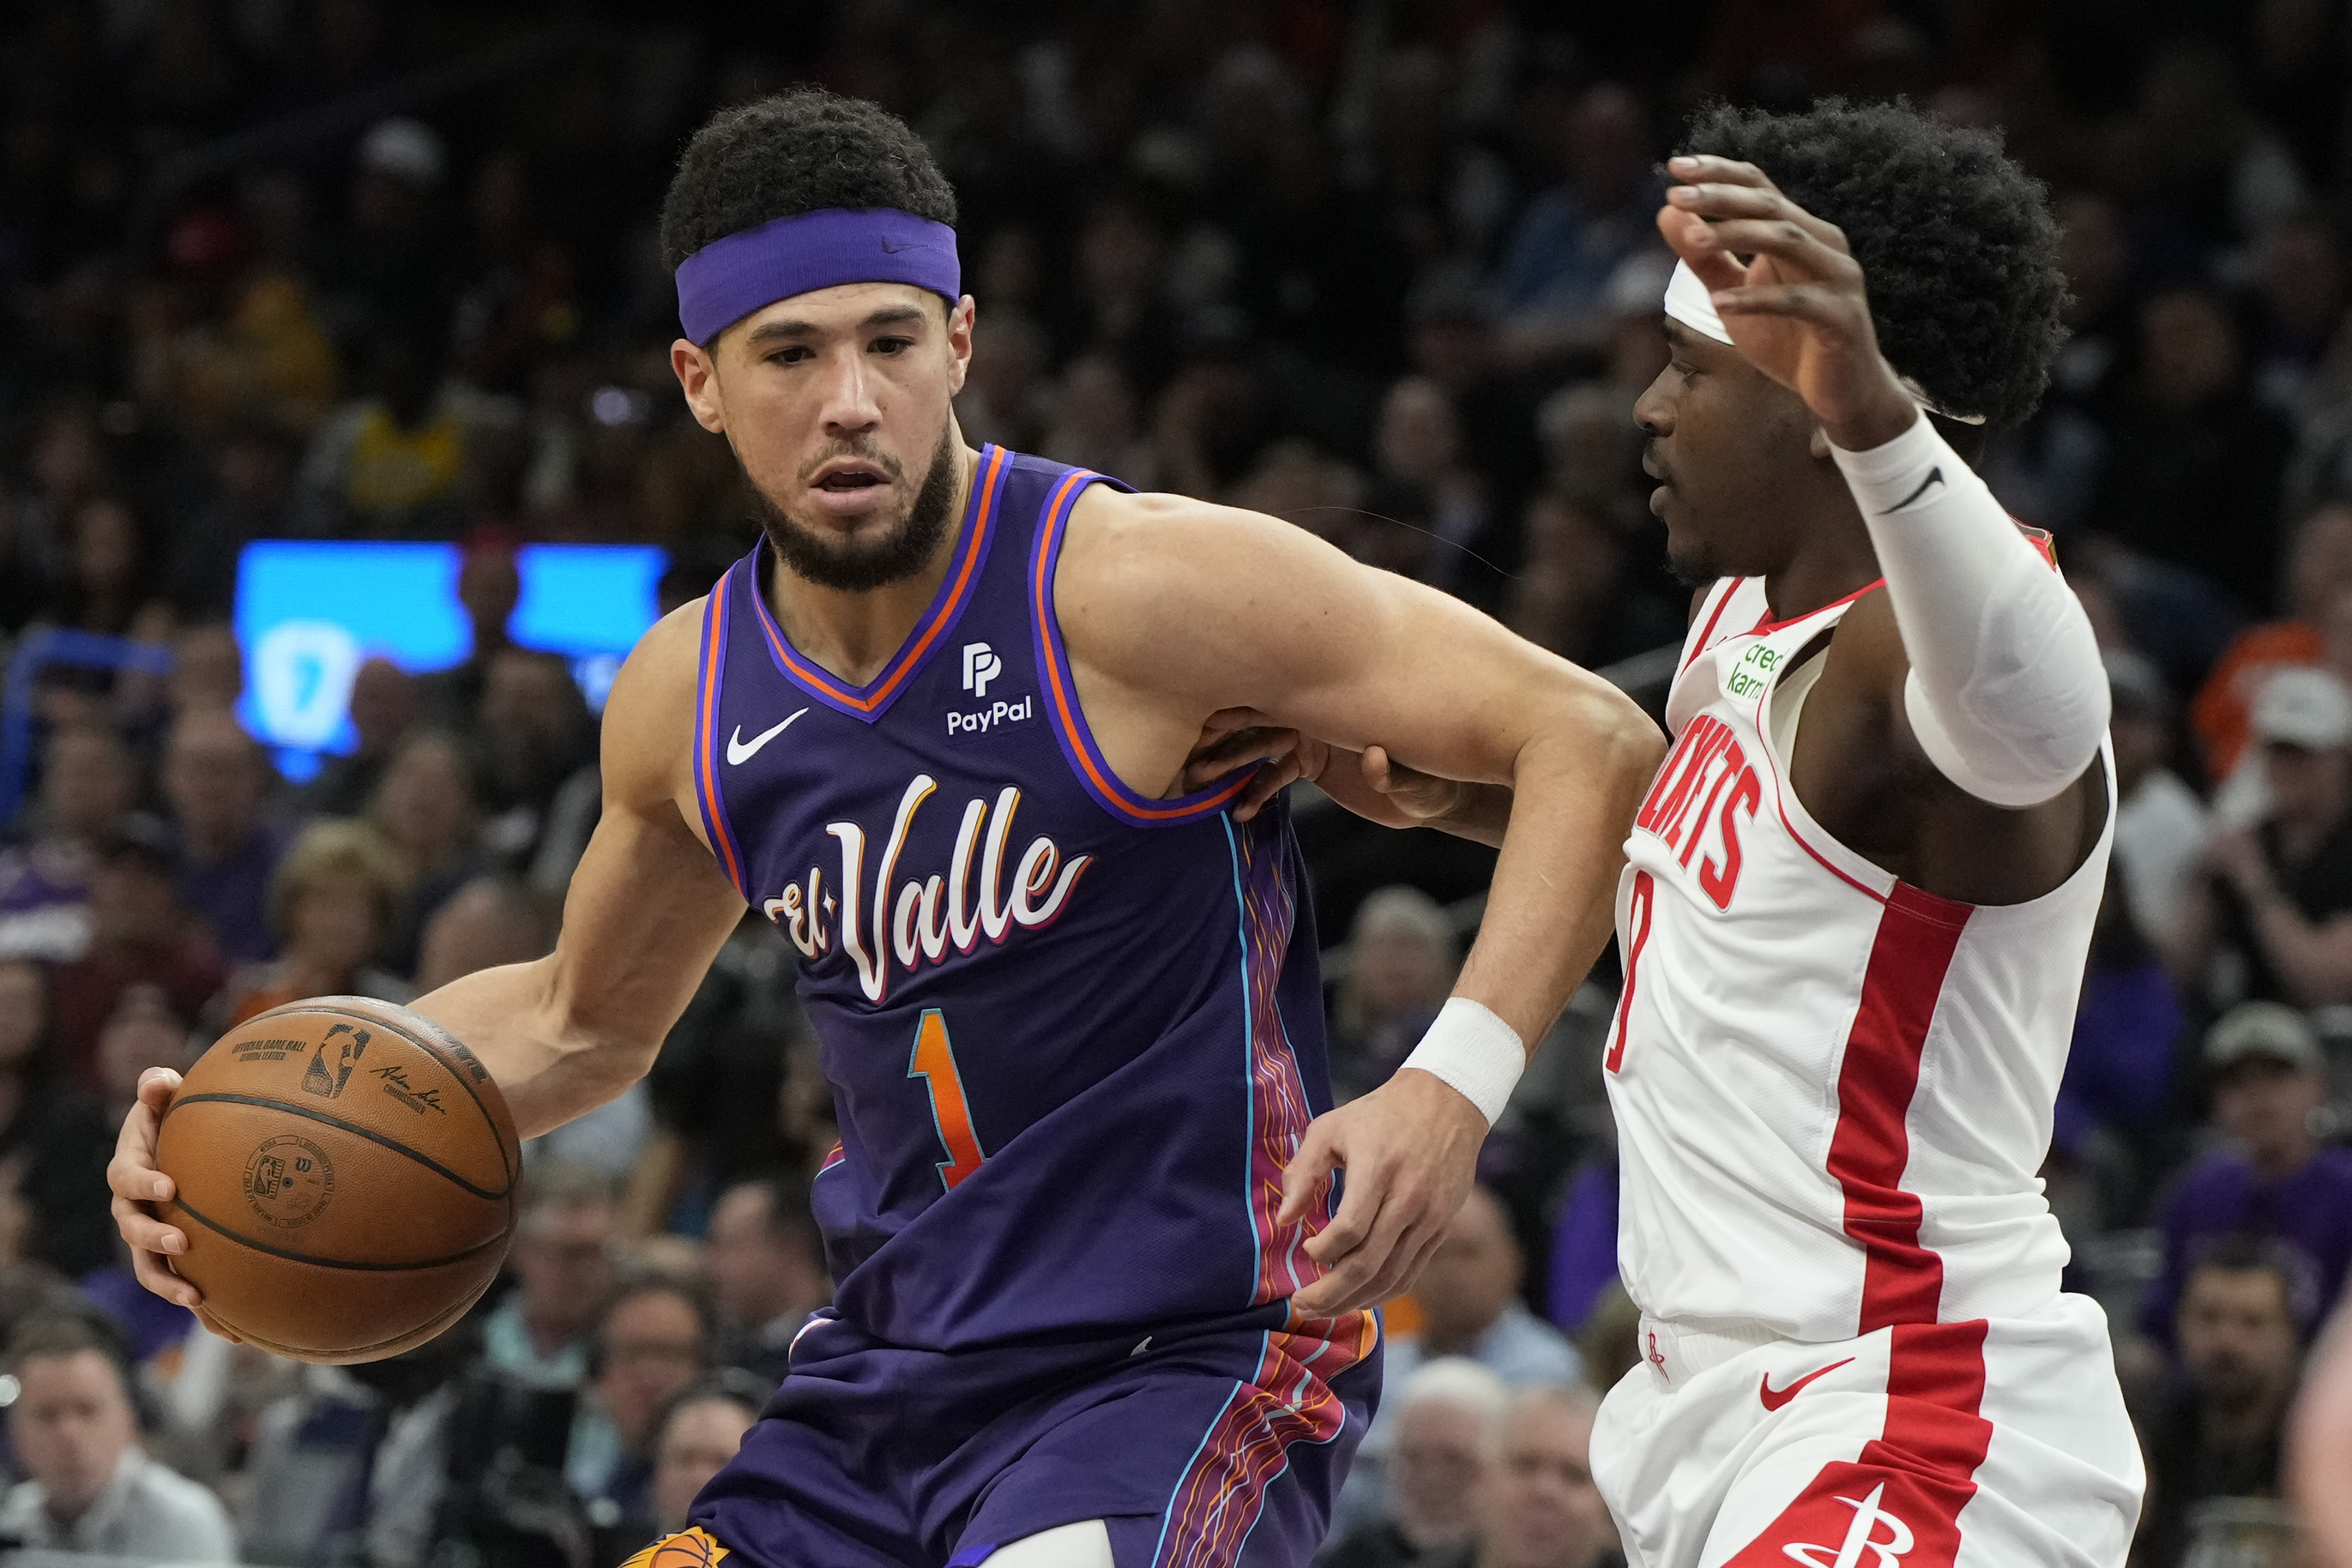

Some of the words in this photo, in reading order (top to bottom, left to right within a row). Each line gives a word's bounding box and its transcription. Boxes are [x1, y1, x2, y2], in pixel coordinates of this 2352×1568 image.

[947, 695, 1032, 735] PayPal
[1636, 713, 1762, 914] CKETS
[763, 867, 826, 960] El
[826, 774, 1095, 1004] Valle
[232, 1040, 264, 1054] OFFICIAL
[263, 1039, 287, 1051] GAME
[286, 1040, 306, 1052] BALL
[383, 1083, 427, 1115] COMMISSIONER
[907, 1008, 986, 1193] 1
